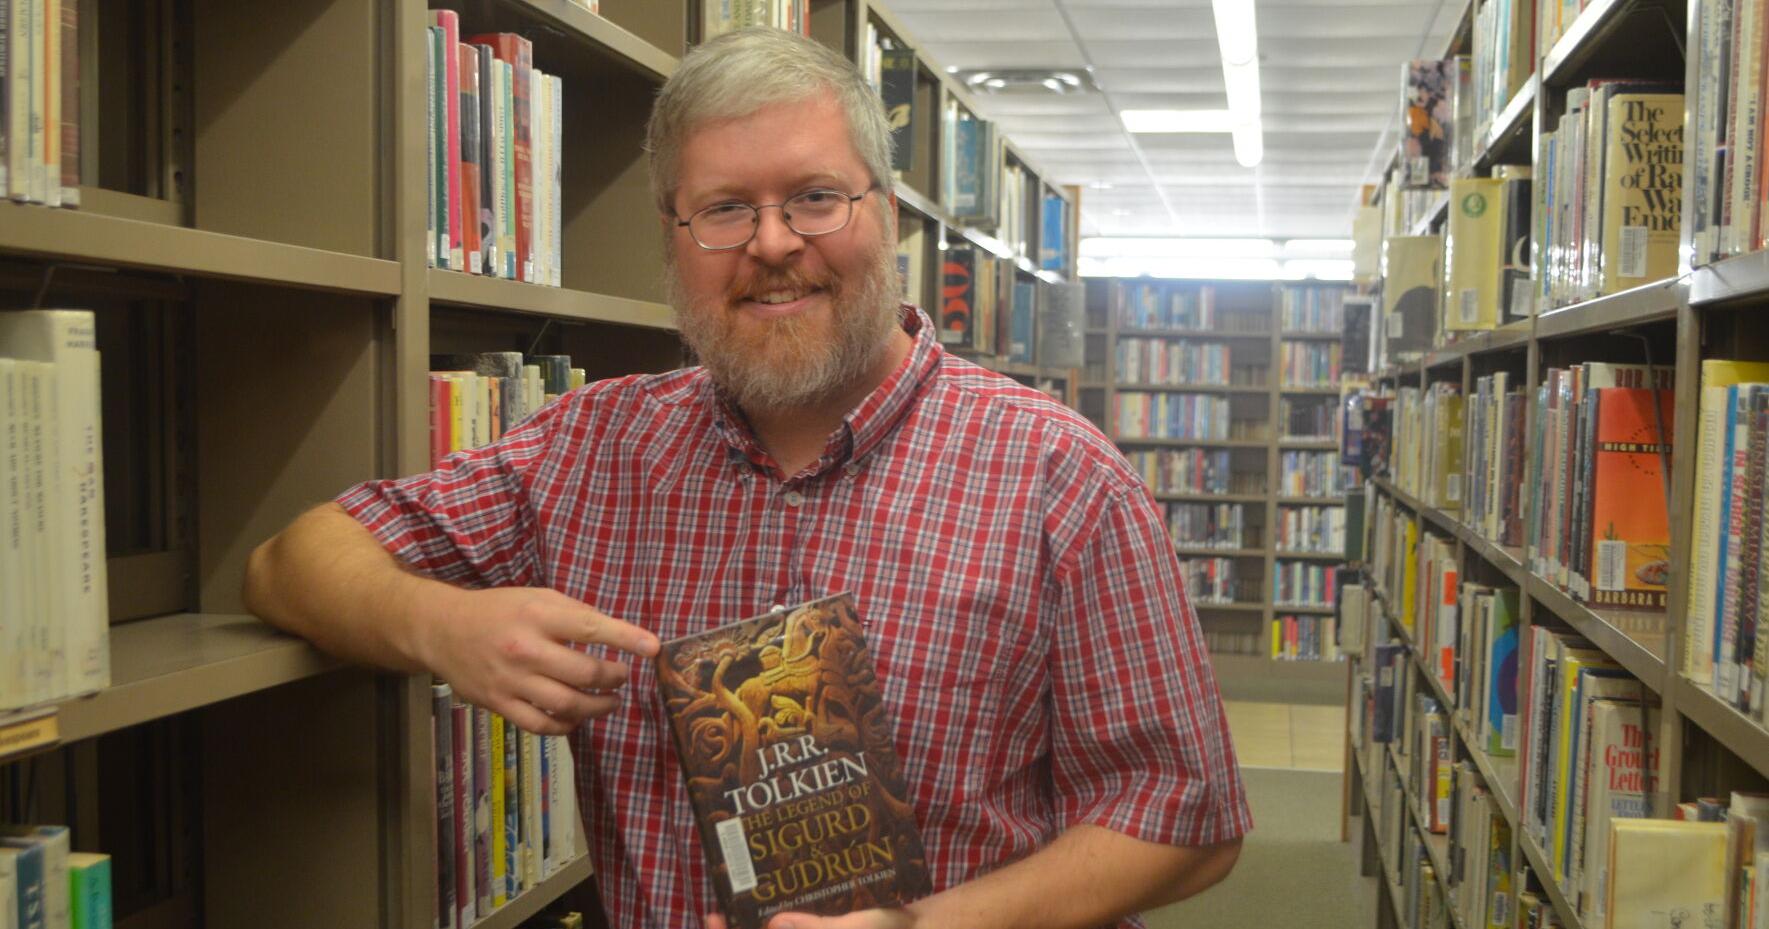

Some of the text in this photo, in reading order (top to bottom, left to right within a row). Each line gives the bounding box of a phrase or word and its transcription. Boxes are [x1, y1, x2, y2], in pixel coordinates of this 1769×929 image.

[1621, 100, 1664, 123] The
[1621, 122, 1684, 144] Select
[1621, 164, 1682, 191] of Ra
[1643, 189, 1682, 214] Wa
[1604, 442, 1637, 453] HIGH
[1745, 428, 1766, 623] ERNEST HEMINGWAY
[1596, 590, 1654, 607] BARBARA
[757, 734, 829, 779] J.R.R.
[724, 751, 868, 815] TOLKIEN
[741, 781, 871, 832] THE LEGEND OF
[750, 803, 871, 861] SIGURD
[751, 836, 895, 901] GUDRÚN
[810, 843, 824, 859] &
[758, 868, 897, 918] Edited by CHRISTOPHER TOLKIEN
